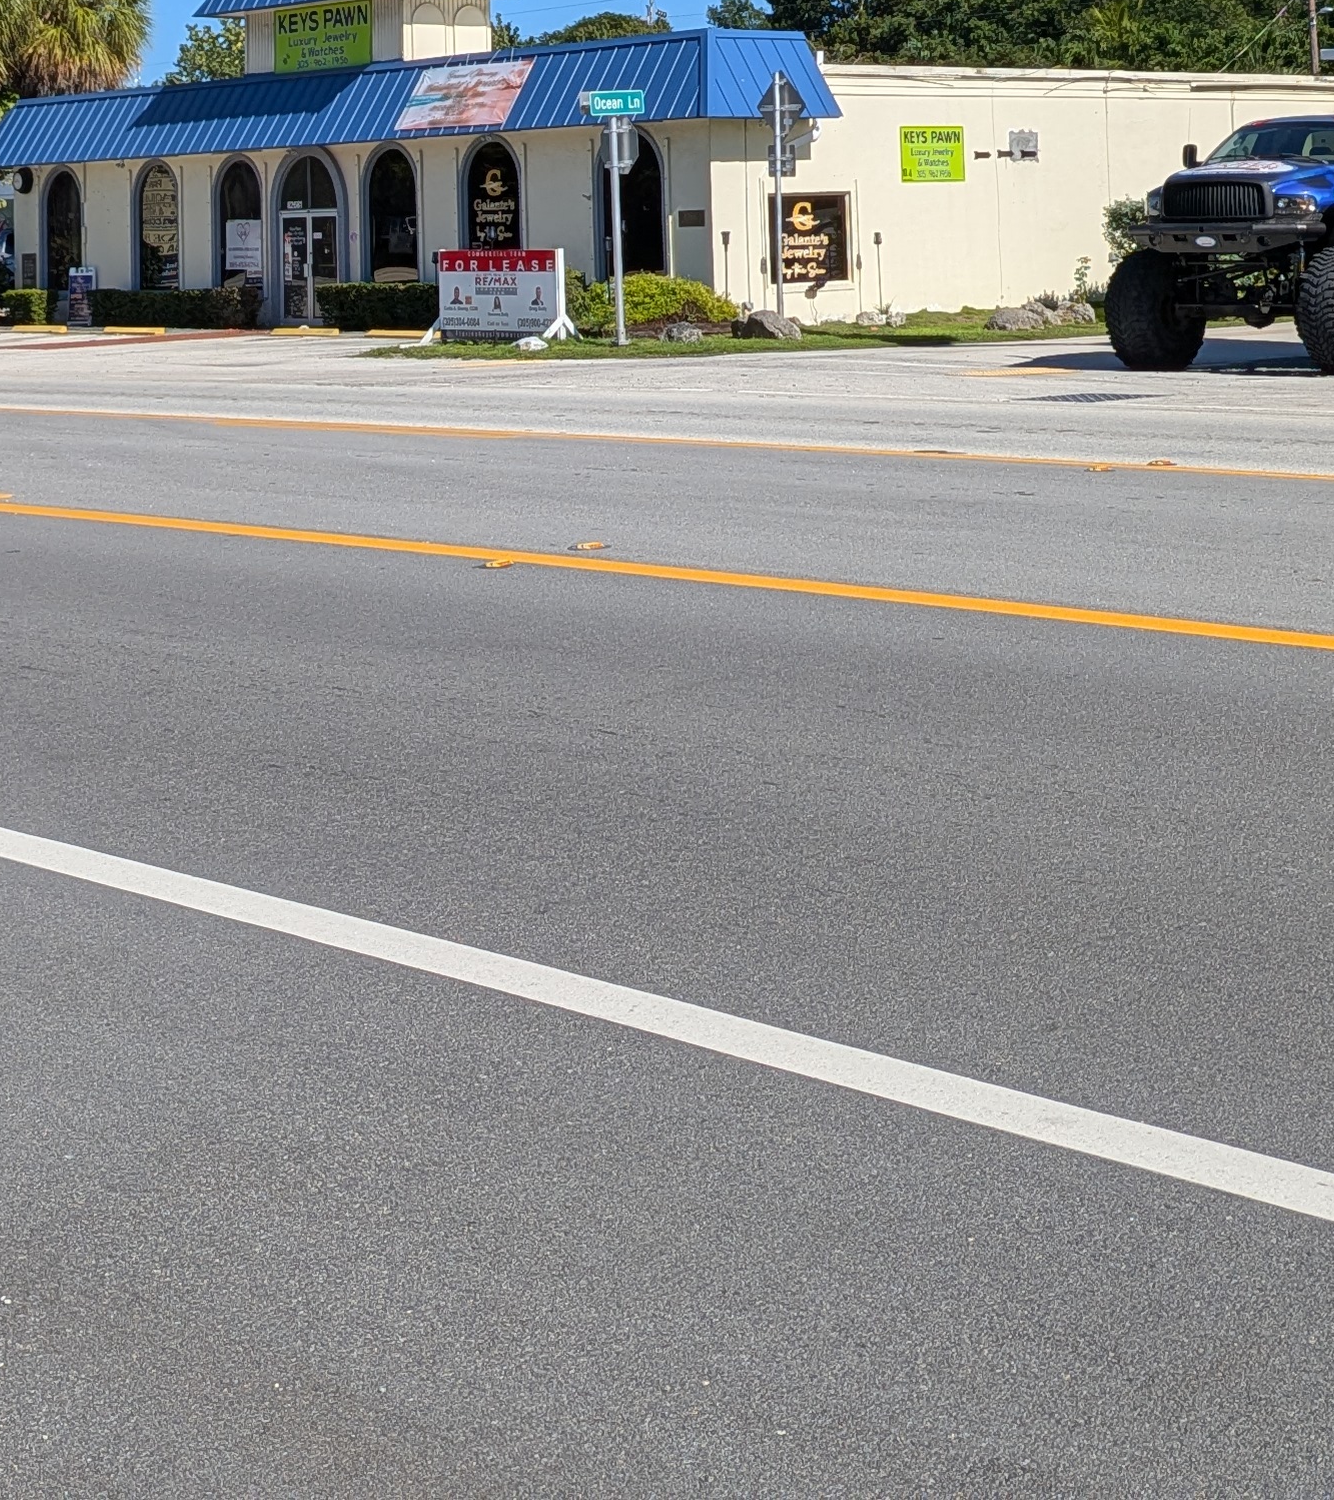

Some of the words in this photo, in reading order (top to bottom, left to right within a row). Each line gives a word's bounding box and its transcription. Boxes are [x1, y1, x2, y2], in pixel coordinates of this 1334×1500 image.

[278, 11, 319, 34] KEYS
[323, 4, 368, 29] PAWN
[288, 37, 317, 47] Luxury
[323, 31, 357, 43] Jewelry
[308, 46, 345, 57] Watches
[594, 96, 624, 110] Ocean
[628, 95, 640, 109] Ln
[903, 131, 927, 143] KEYS
[931, 131, 960, 143] PAWN
[474, 199, 515, 210] Galante's
[476, 211, 513, 225] Jewelry
[782, 246, 826, 260] Jewelry
[443, 260, 478, 271] FOR
[489, 260, 553, 271] LEASE
[475, 277, 517, 286] RE/MAX
